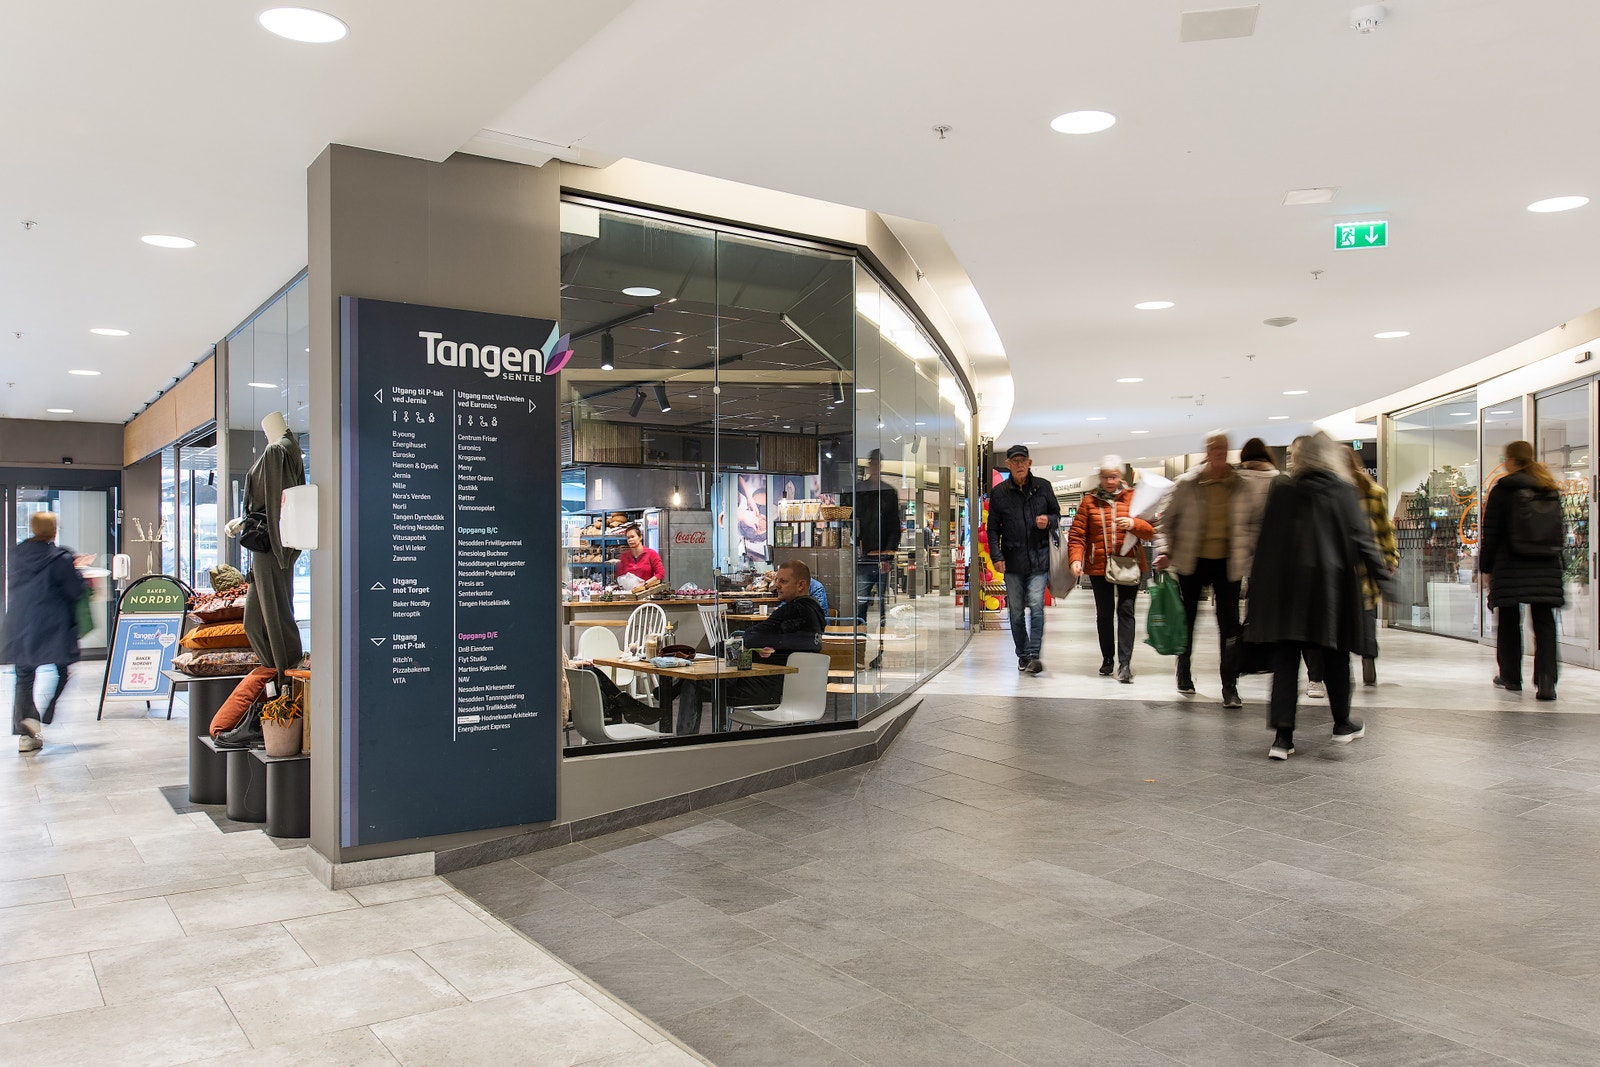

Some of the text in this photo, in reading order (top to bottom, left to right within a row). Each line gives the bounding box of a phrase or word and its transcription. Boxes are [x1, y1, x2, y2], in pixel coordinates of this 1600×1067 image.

[419, 331, 543, 377] Tangen
[502, 372, 542, 383] SENTER
[392, 387, 416, 396] Utgang
[426, 389, 444, 397] P-tak
[458, 391, 480, 401] Utgang
[495, 394, 524, 402] Vestveien
[405, 397, 427, 405] Jernia
[470, 401, 497, 409] Euronics
[392, 431, 415, 439] B.young
[392, 441, 426, 449] Energihuset
[458, 444, 481, 452] Euronics
[421, 462, 439, 470] Dysvik
[458, 464, 472, 472] Meny
[393, 524, 416, 532] Telering
[458, 527, 486, 535] Oppgang
[458, 550, 485, 558] Kinesiolog
[458, 560, 525, 568] Nesoddtangen Legesenter
[393, 578, 417, 586] Utgang
[130, 595, 179, 604] NORDBY
[479, 599, 510, 607] Helseklinikk
[410, 600, 430, 608] Nordby
[133, 632, 156, 640] Tangen
[393, 634, 417, 642] Utgang
[458, 632, 486, 641] Oppgang
[479, 664, 507, 672] Kjøreskole
[485, 683, 515, 691] Kirkesenter
[481, 713, 511, 721] Hodnekvam
[458, 725, 489, 733] Energihuset
